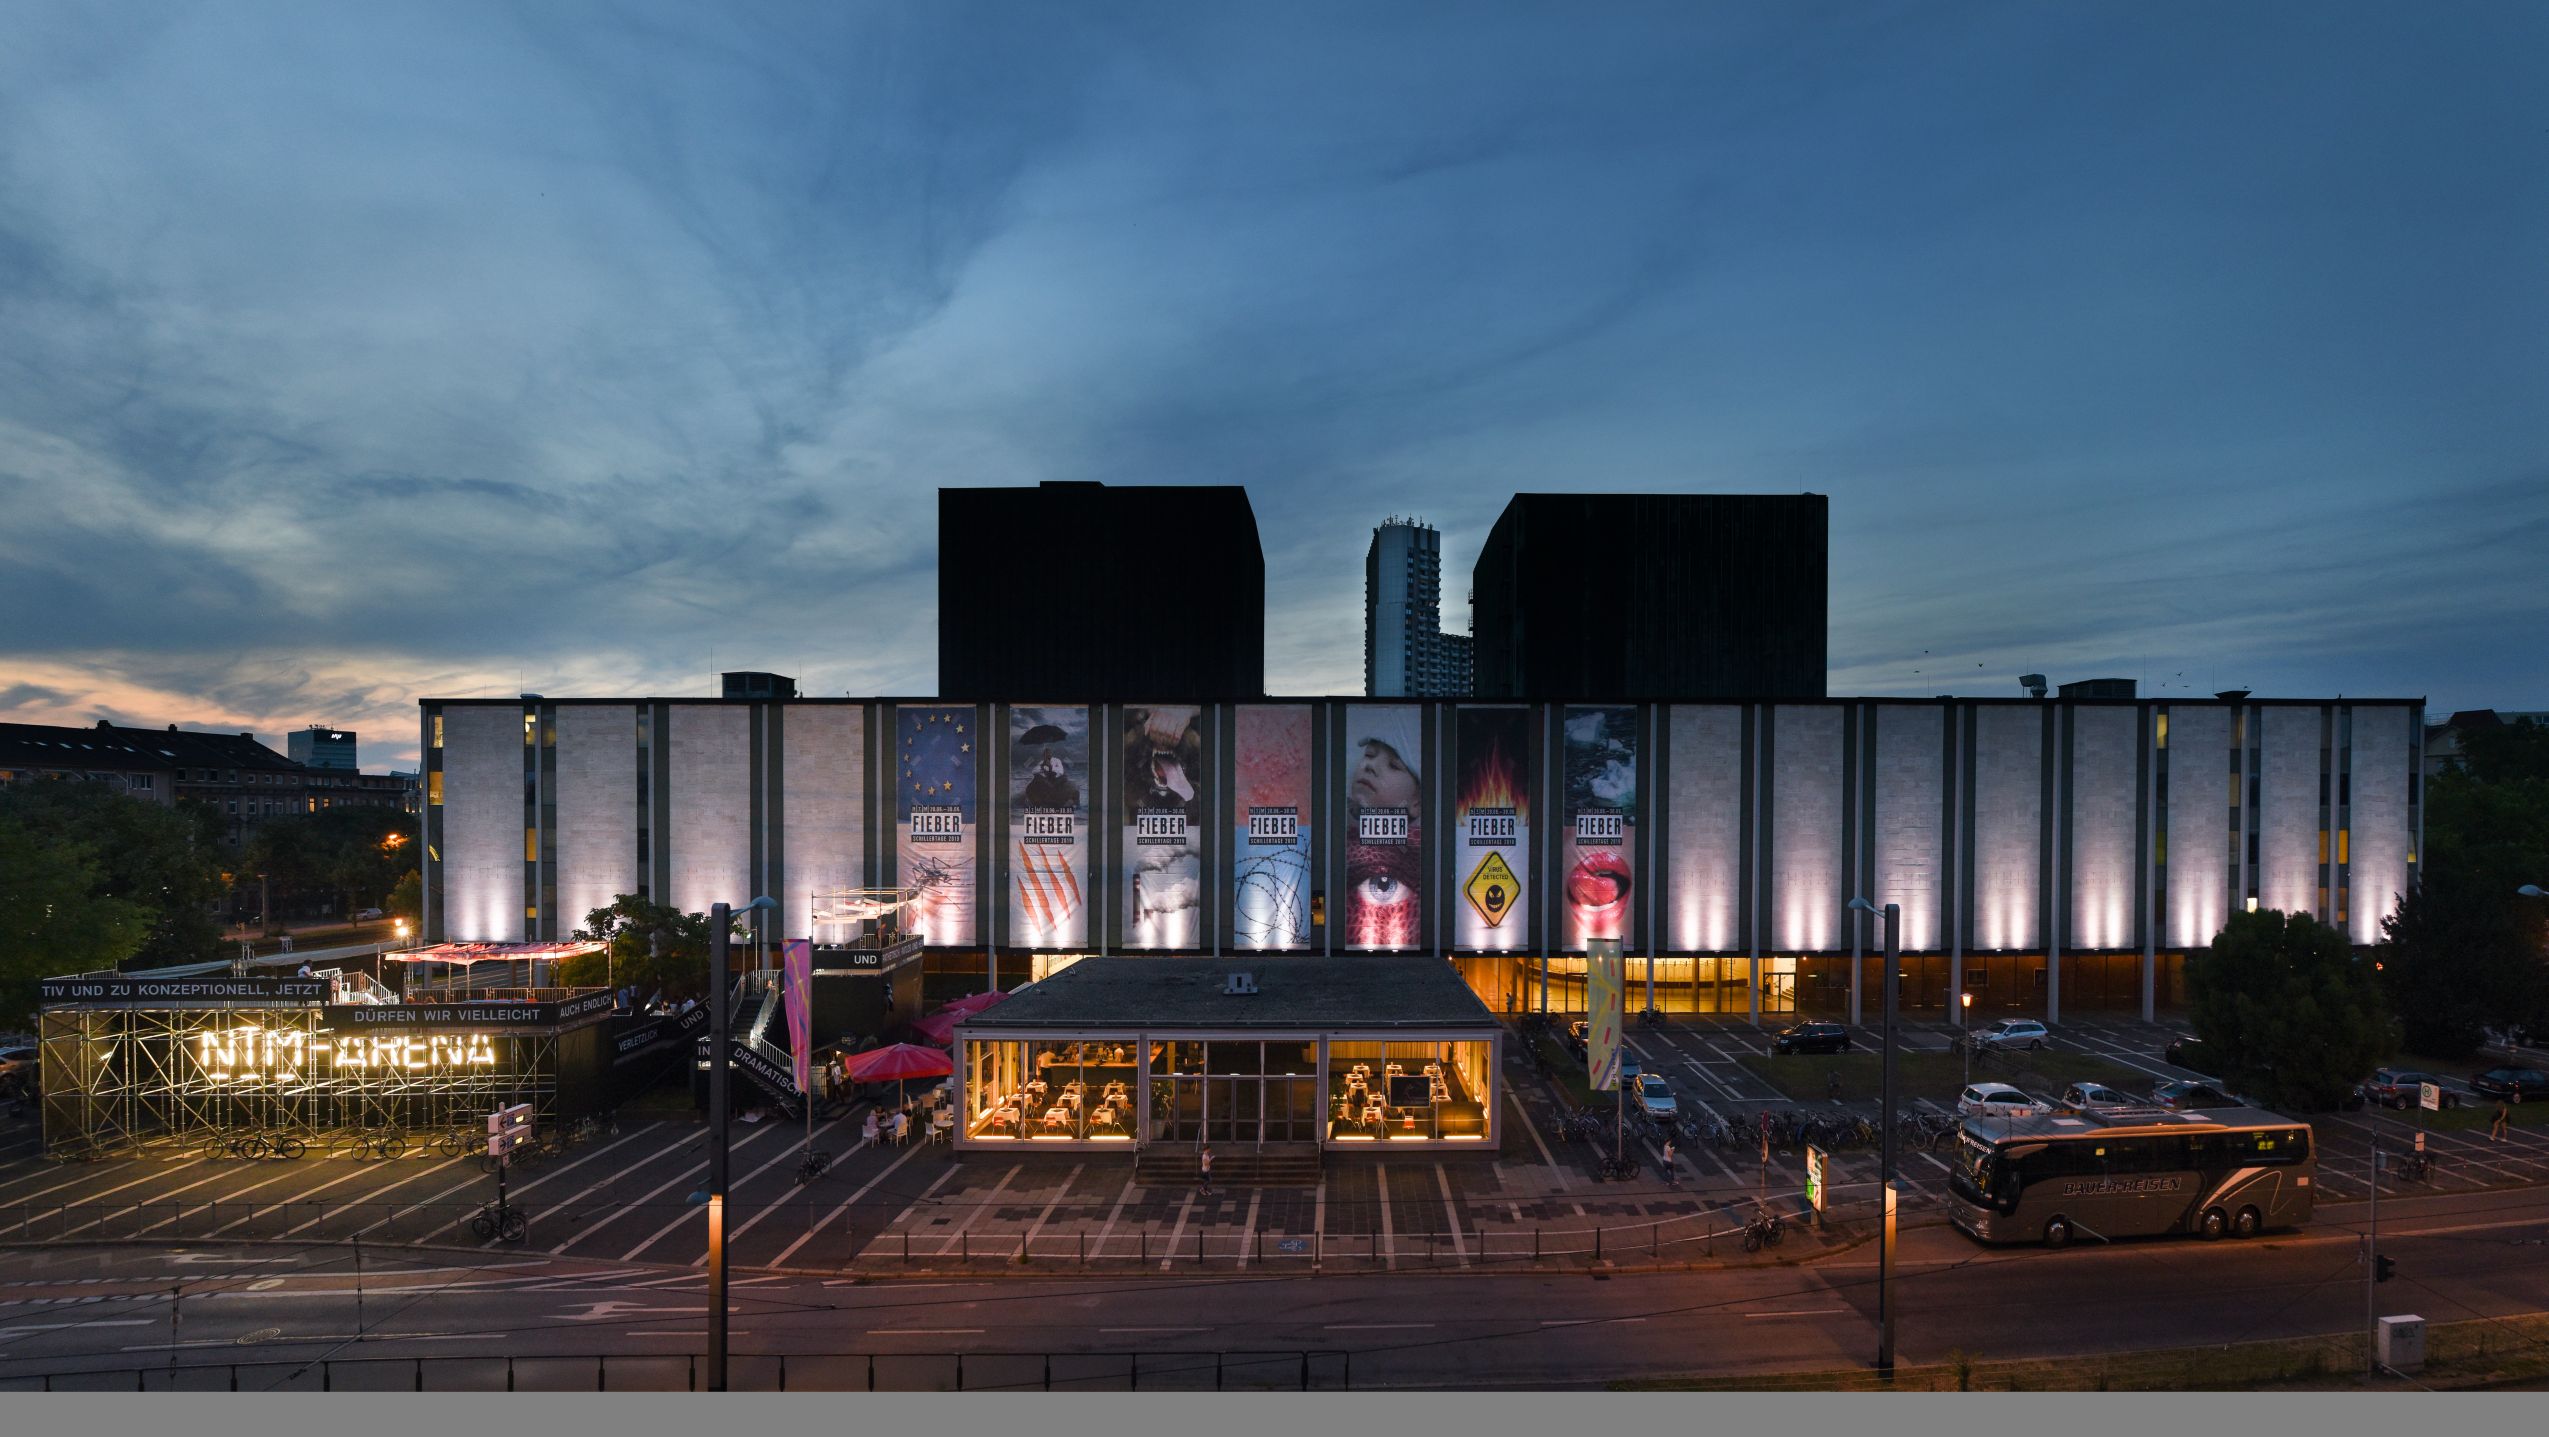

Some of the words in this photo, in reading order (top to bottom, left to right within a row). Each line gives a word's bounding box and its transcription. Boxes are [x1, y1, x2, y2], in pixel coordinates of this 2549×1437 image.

[913, 815, 960, 833] FIEBER
[1026, 817, 1072, 834] FIEBER
[1139, 817, 1185, 835] FIEBER
[1250, 817, 1296, 835] FIEBER
[1361, 818, 1406, 835] FIEBER
[1471, 818, 1515, 835] FIEBER
[1578, 818, 1621, 835] FIEBER
[854, 955, 877, 964] UND
[42, 986, 65, 996] TIV
[72, 985, 104, 996] UND
[110, 985, 130, 996] ZU
[138, 984, 270, 997] KONZEPTIONELL,
[275, 984, 322, 995] JETZT
[560, 1003, 580, 1018] AUCH
[583, 993, 612, 1011] ENDLICH
[354, 1008, 416, 1022] DÜRFEN
[424, 1010, 451, 1021] WIR
[458, 1009, 541, 1021] VIELLEICHT
[680, 1010, 704, 1029] UND
